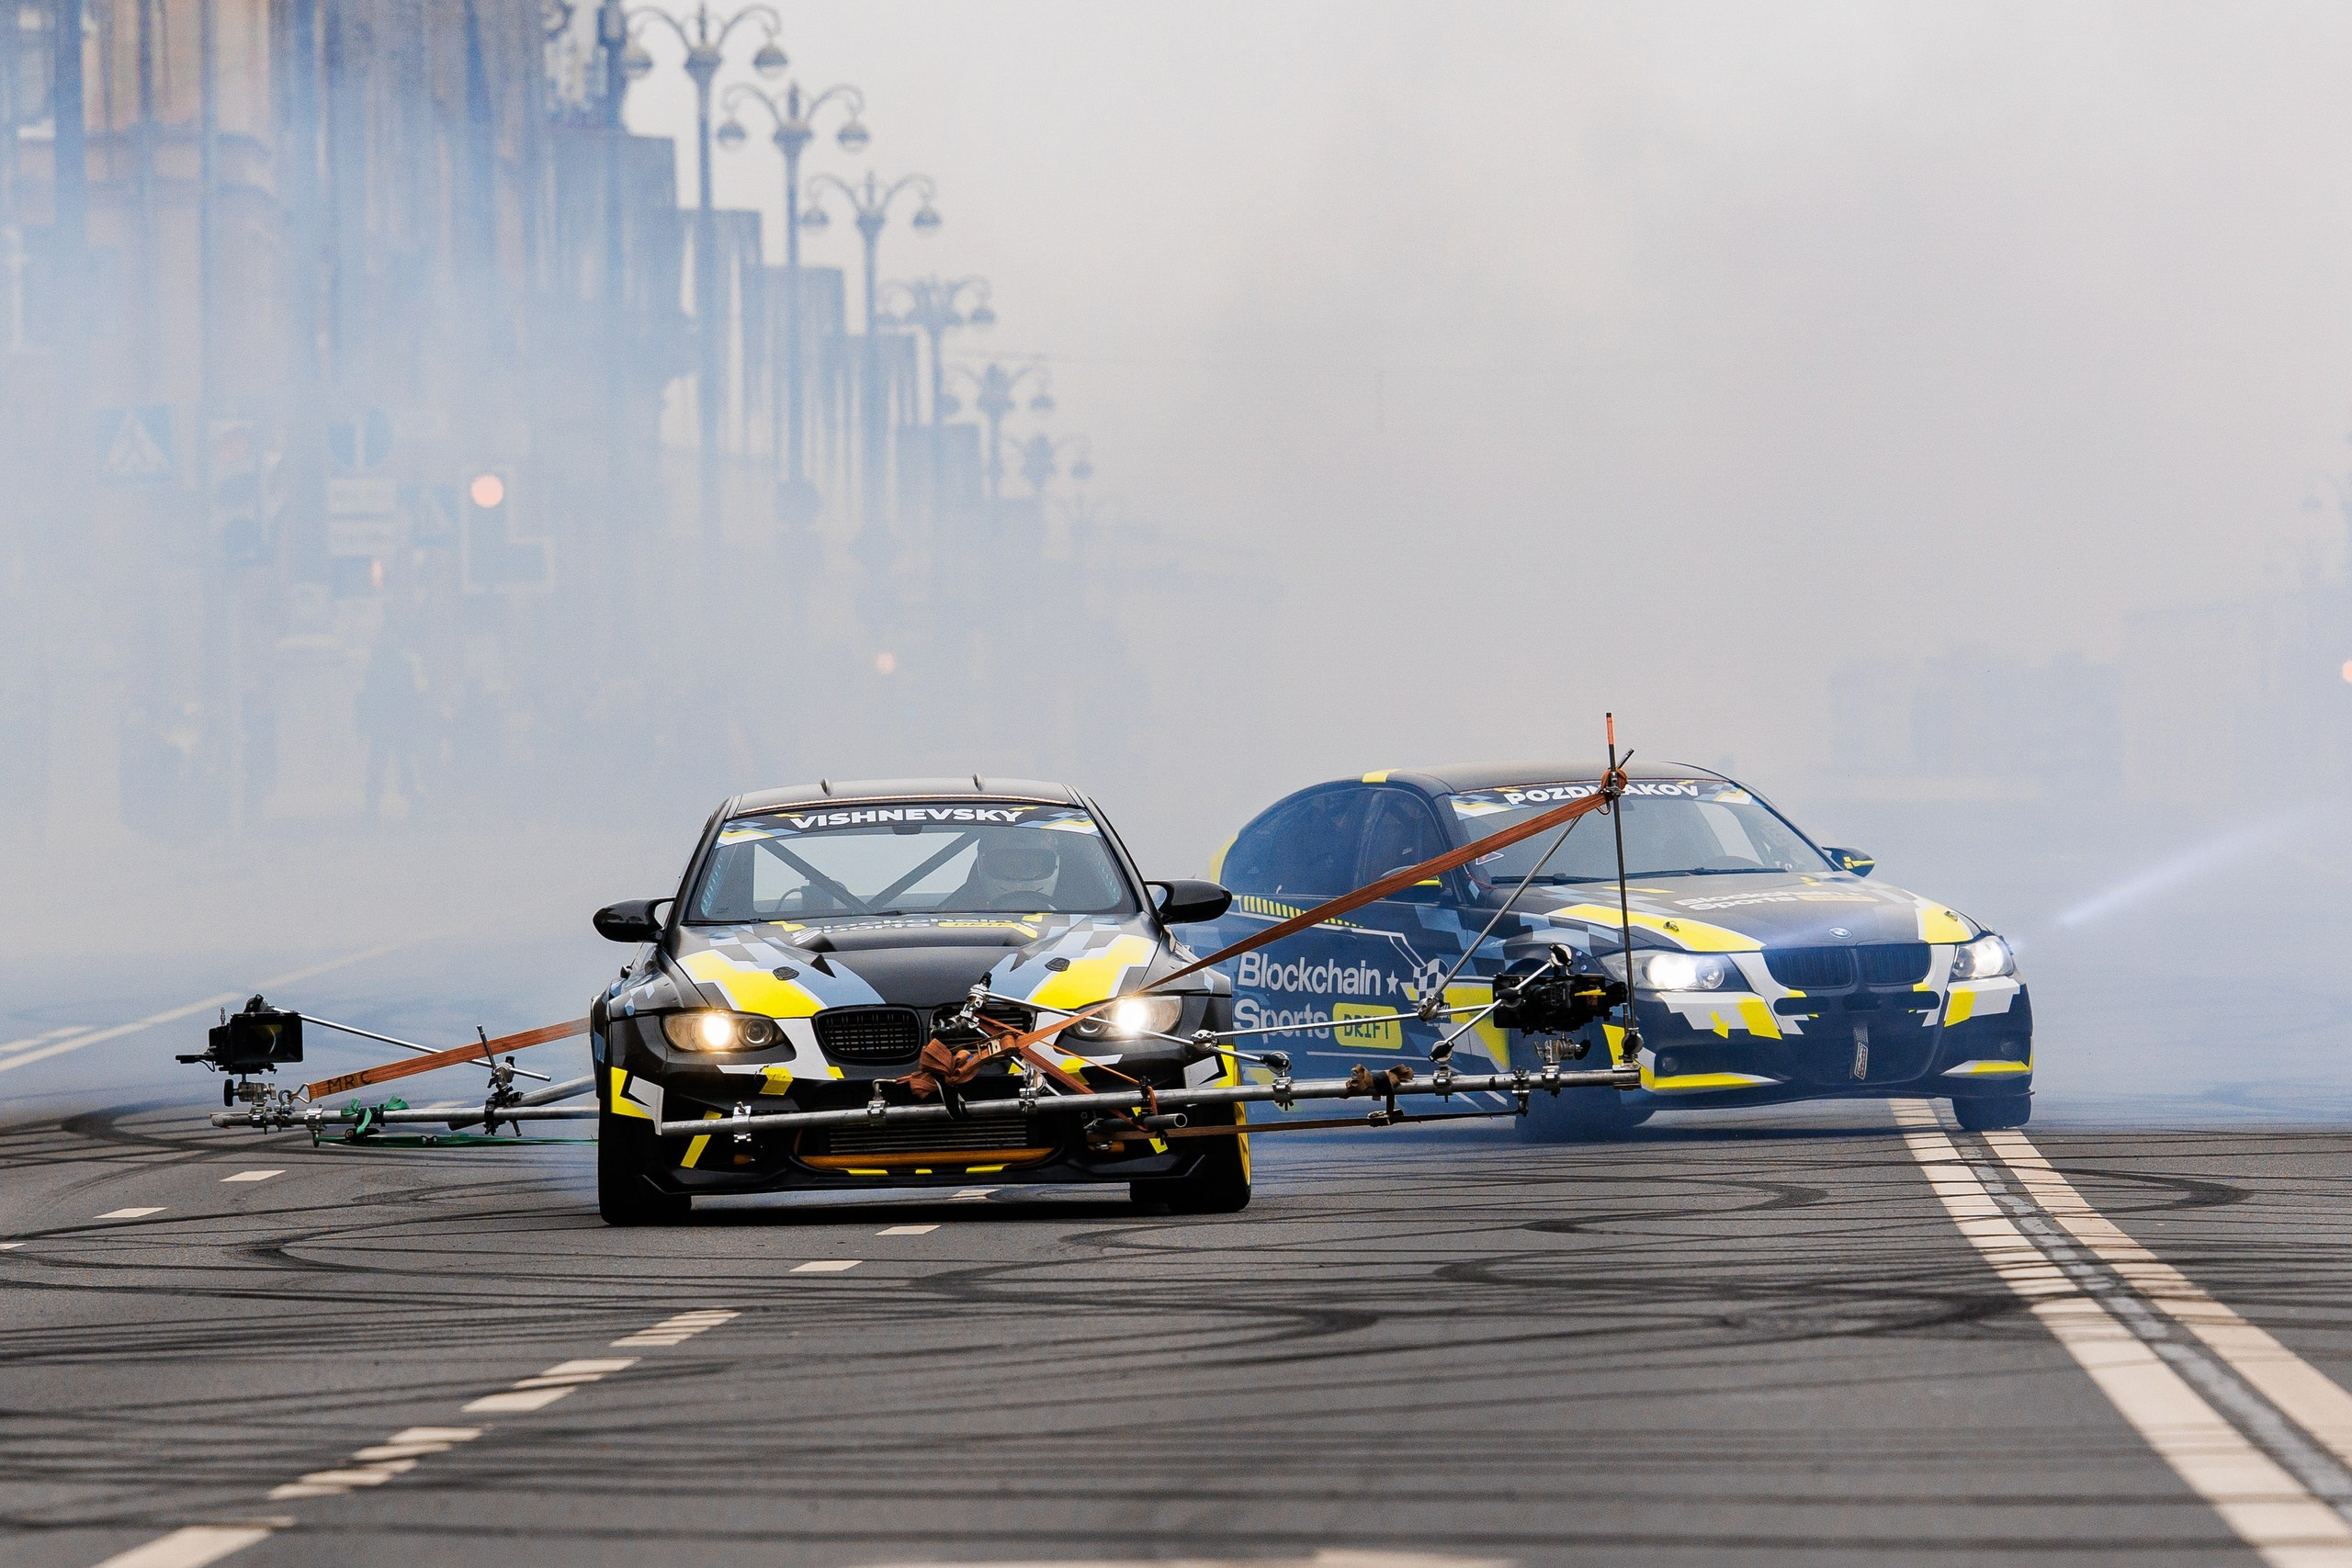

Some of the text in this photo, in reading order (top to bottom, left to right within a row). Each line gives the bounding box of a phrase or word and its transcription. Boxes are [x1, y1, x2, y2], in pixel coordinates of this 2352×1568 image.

[1503, 784, 1699, 806] POZDNAKOV
[790, 808, 1023, 829] VISHNEVSKY
[1238, 951, 1381, 997] Blockchain
[1233, 998, 1329, 1043] Sports
